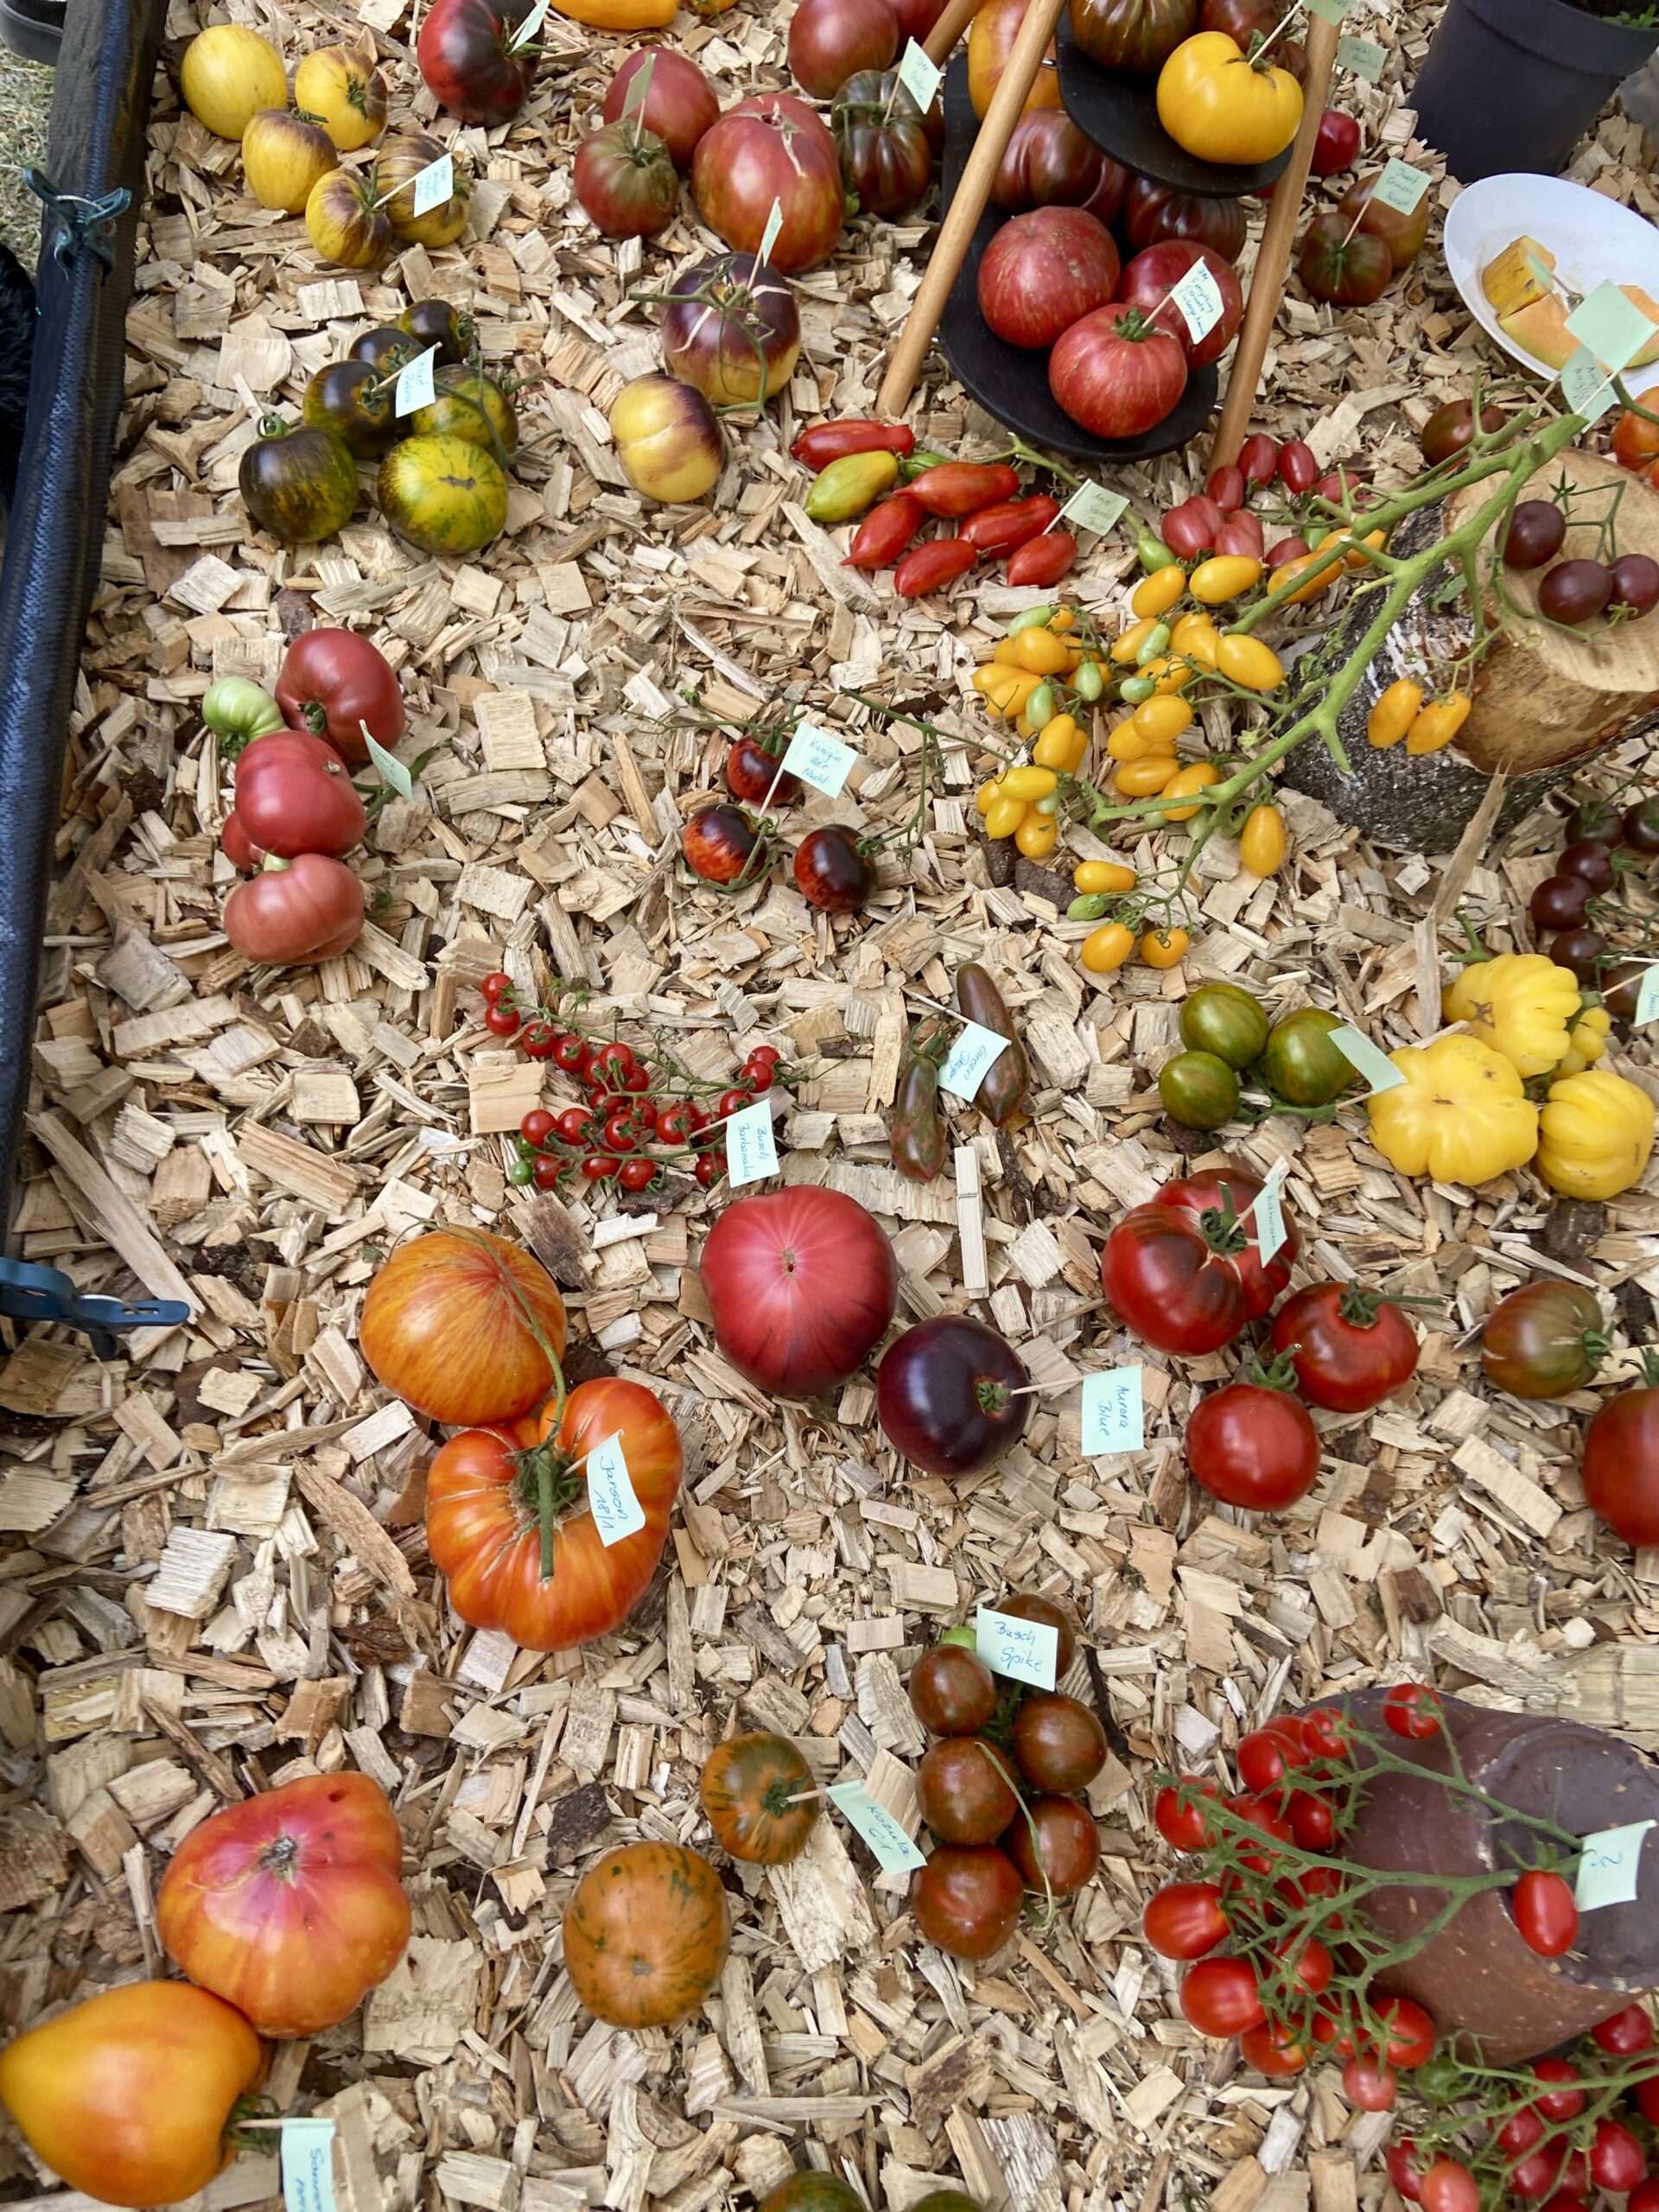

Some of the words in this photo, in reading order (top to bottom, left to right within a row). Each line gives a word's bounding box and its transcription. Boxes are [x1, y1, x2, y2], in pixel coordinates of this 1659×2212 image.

[963, 1045, 988, 1081] Green
[1097, 1399, 1113, 1436] Blue
[1116, 1384, 1130, 1428] Aurora
[995, 1621, 1036, 1646] Busch
[1001, 1646, 1043, 1673] Spike
